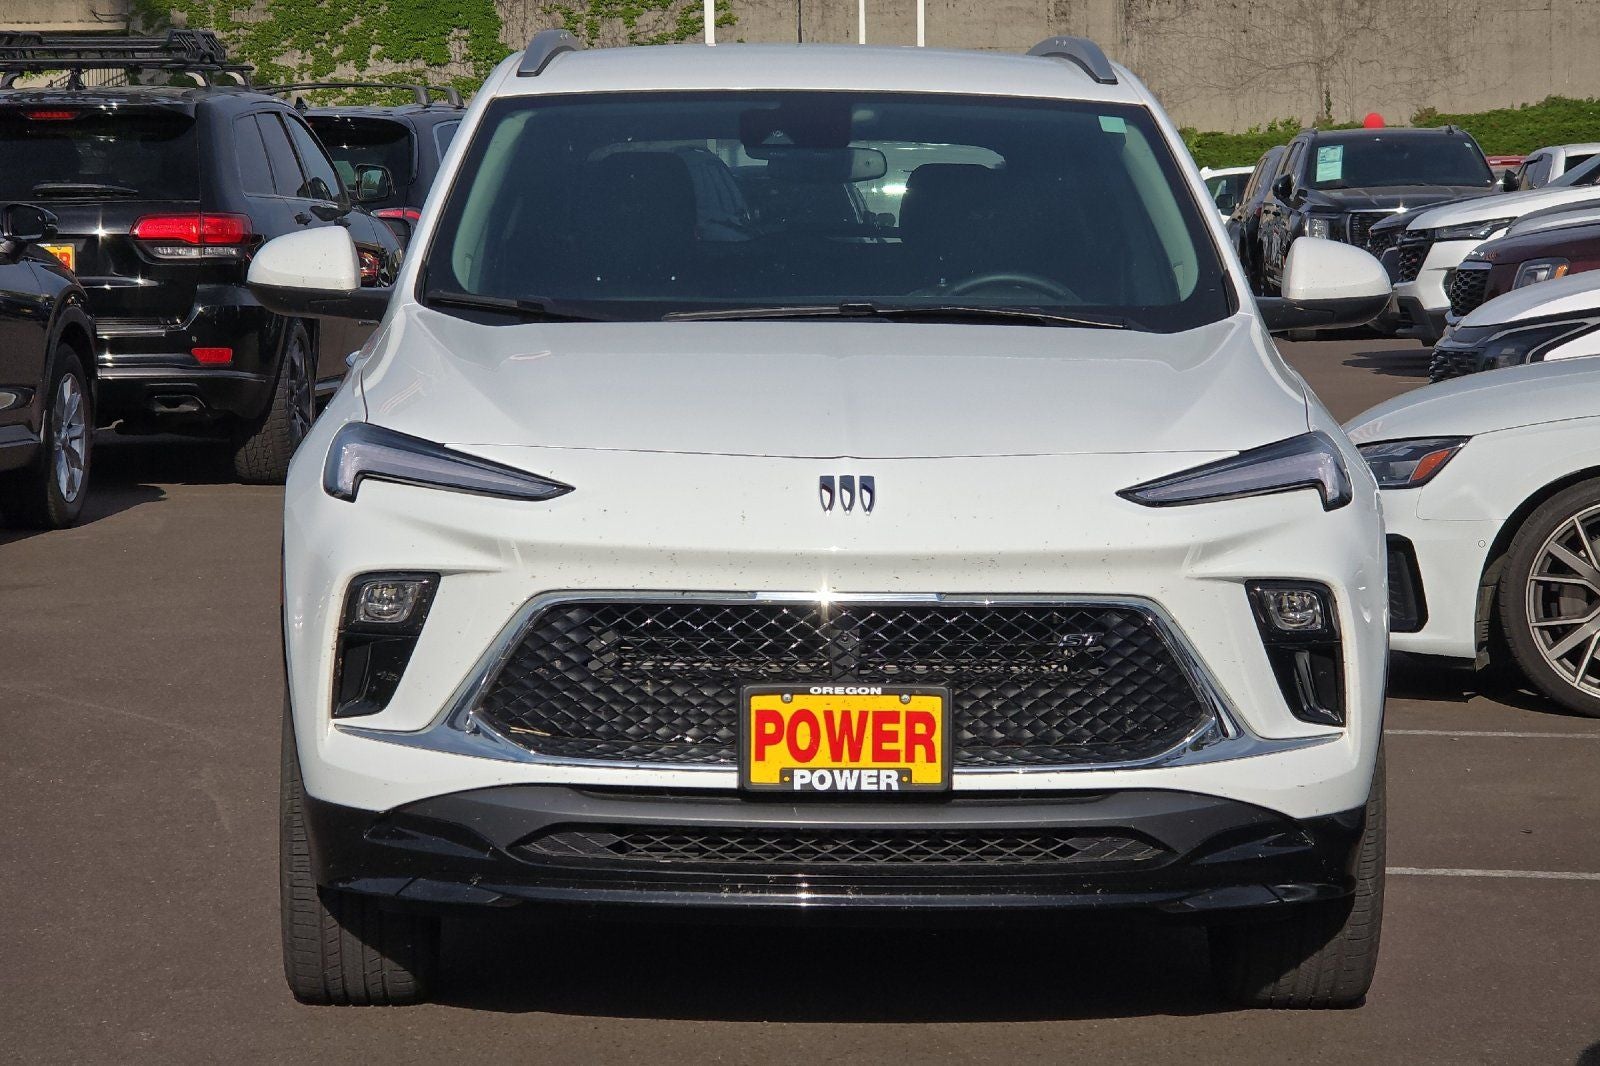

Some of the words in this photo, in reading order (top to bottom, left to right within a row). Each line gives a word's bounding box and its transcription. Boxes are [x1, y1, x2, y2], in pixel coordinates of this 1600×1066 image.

[809, 686, 882, 695] OREGON
[755, 709, 937, 763] POWER
[793, 769, 899, 791] POWER
